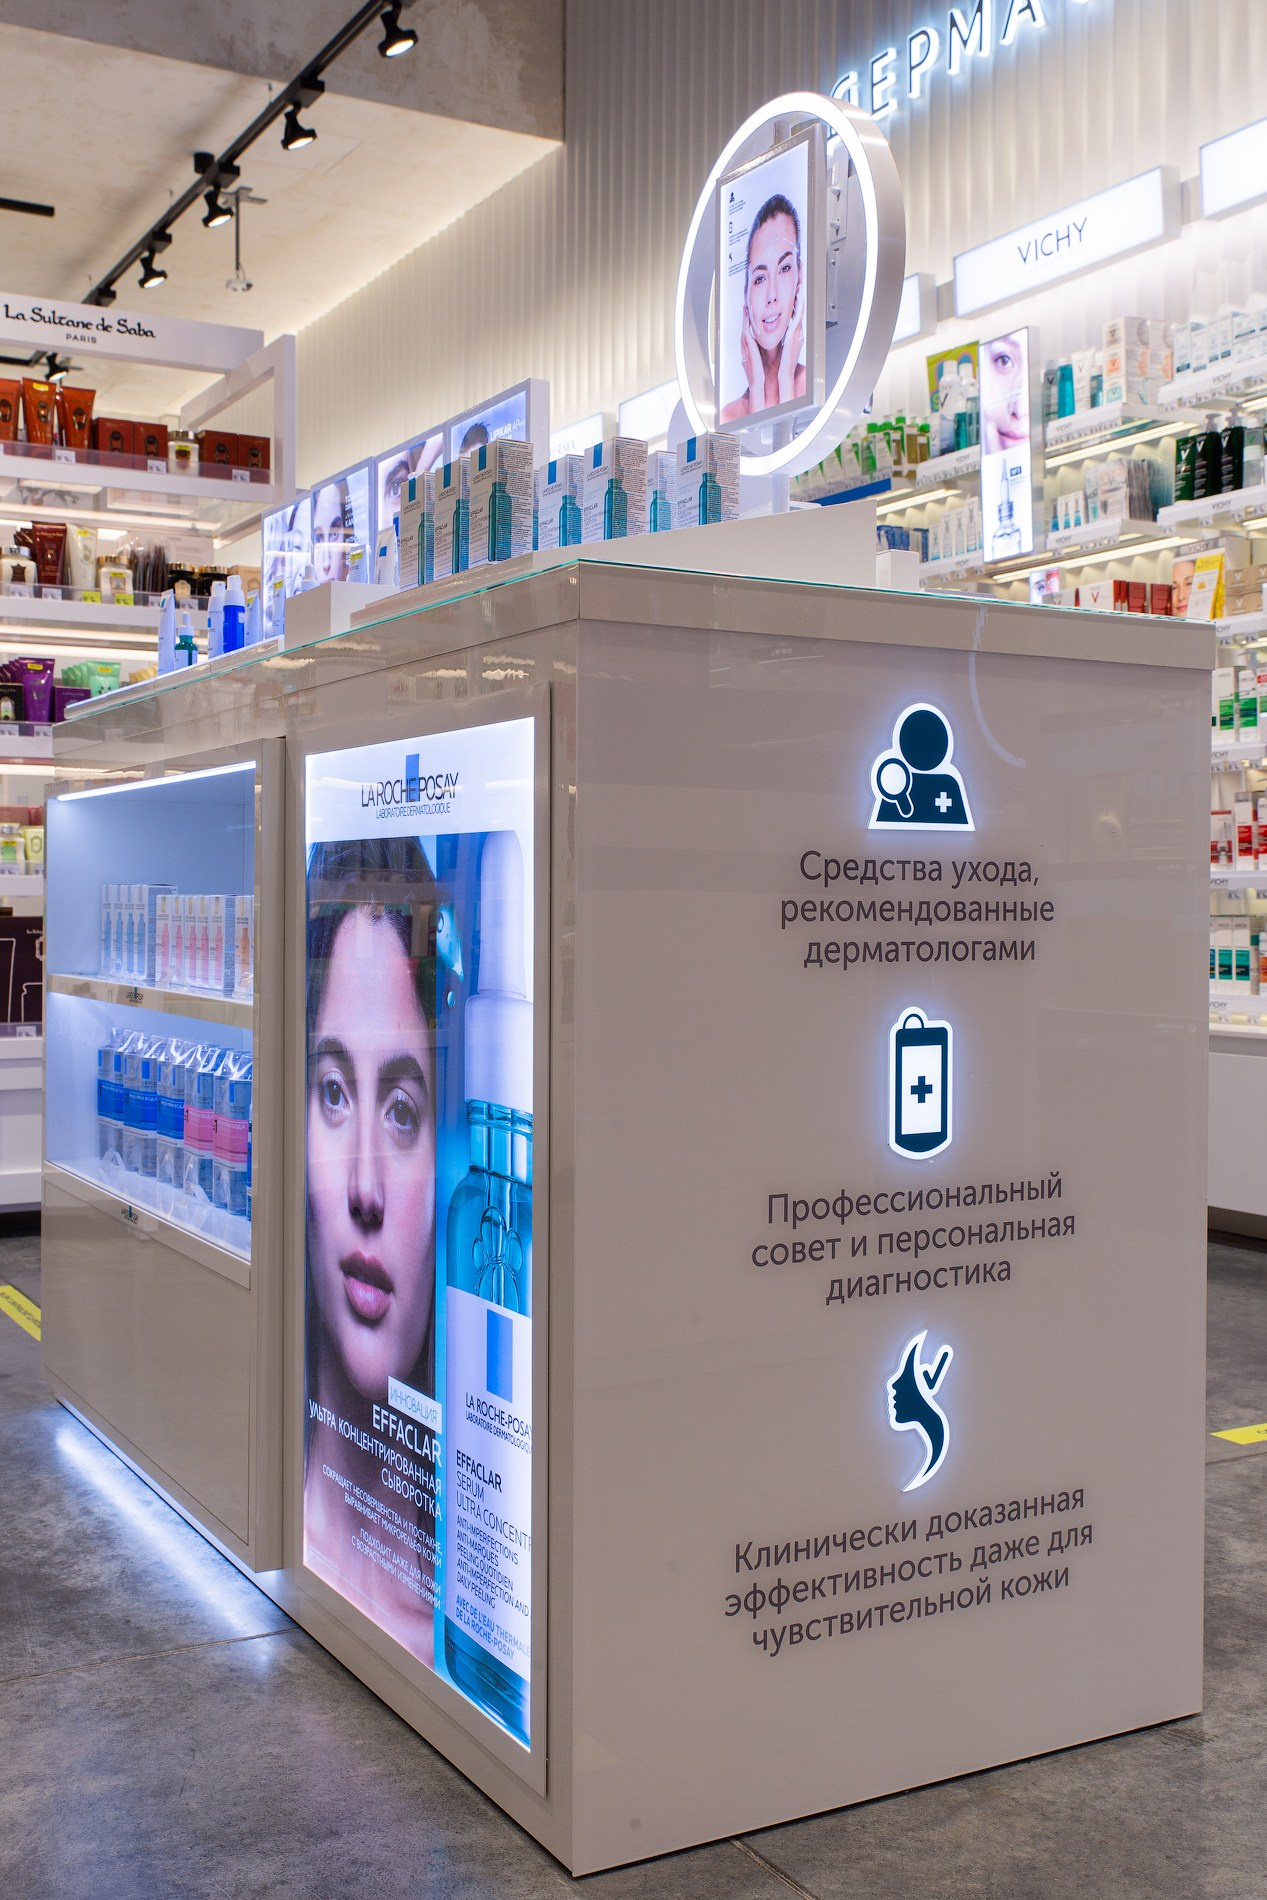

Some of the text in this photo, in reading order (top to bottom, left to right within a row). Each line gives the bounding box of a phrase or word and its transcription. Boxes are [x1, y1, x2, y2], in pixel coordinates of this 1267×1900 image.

[1017, 217, 1088, 264] VICHY
[4, 303, 156, 338] La Sultane de Saba
[66, 333, 97, 344] PARIS
[1212, 500, 1232, 510] VICHY
[361, 784, 376, 807] LA
[800, 851, 1038, 889] Средства ухода,
[782, 900, 1054, 929] рекомендованные
[804, 937, 1036, 970] дерматологами
[769, 1171, 1061, 1229] Профессиональный
[752, 1216, 1074, 1267] совет и персональная
[826, 1261, 1010, 1305] диагностика
[390, 1386, 438, 1424] ИННОВАЦИЯ
[466, 1392, 475, 1411] LA
[466, 1410, 493, 1434] LABORATOIRE
[309, 1399, 441, 1497] УЛЬТРА КОНЦЕНТРИРОВАННАЯ
[372, 1403, 442, 1468] EFFACLAR
[456, 1449, 502, 1493] EFFACLAR
[456, 1470, 484, 1503] SERUM
[322, 1464, 352, 1493] СОКРАЩАЕТ
[353, 1484, 402, 1527] НЕСОВЕРШЕНСТВА
[403, 1518, 408, 1531] И
[381, 1467, 442, 1522] СЫВОРОТКА
[456, 1490, 482, 1521] ULTRA
[344, 1492, 442, 1569] ВЫРАВНИВАЕТ МИКРОРЕЛЬЕФ КОЖИ
[735, 1488, 1084, 1573] Клинически доказанная
[351, 1535, 356, 1546] С
[356, 1539, 397, 1578] ВОЗРАСТНЫМИ
[360, 1528, 441, 1596] ПОДХОДИТ ДАЖЕ ДЛЯ КОЖИ
[456, 1543, 513, 1592] PEELING QUOTIDIEN
[724, 1524, 1093, 1619] эффективность даже для
[456, 1571, 496, 1609] DAILY PEELING
[514, 1599, 529, 1617] AND
[752, 1567, 1069, 1657] чувствительной кожи
[456, 1594, 530, 1658] AVEC DE L'EAU THERMALE
[456, 1607, 515, 1660] DE LA ROCHE-POSAY
